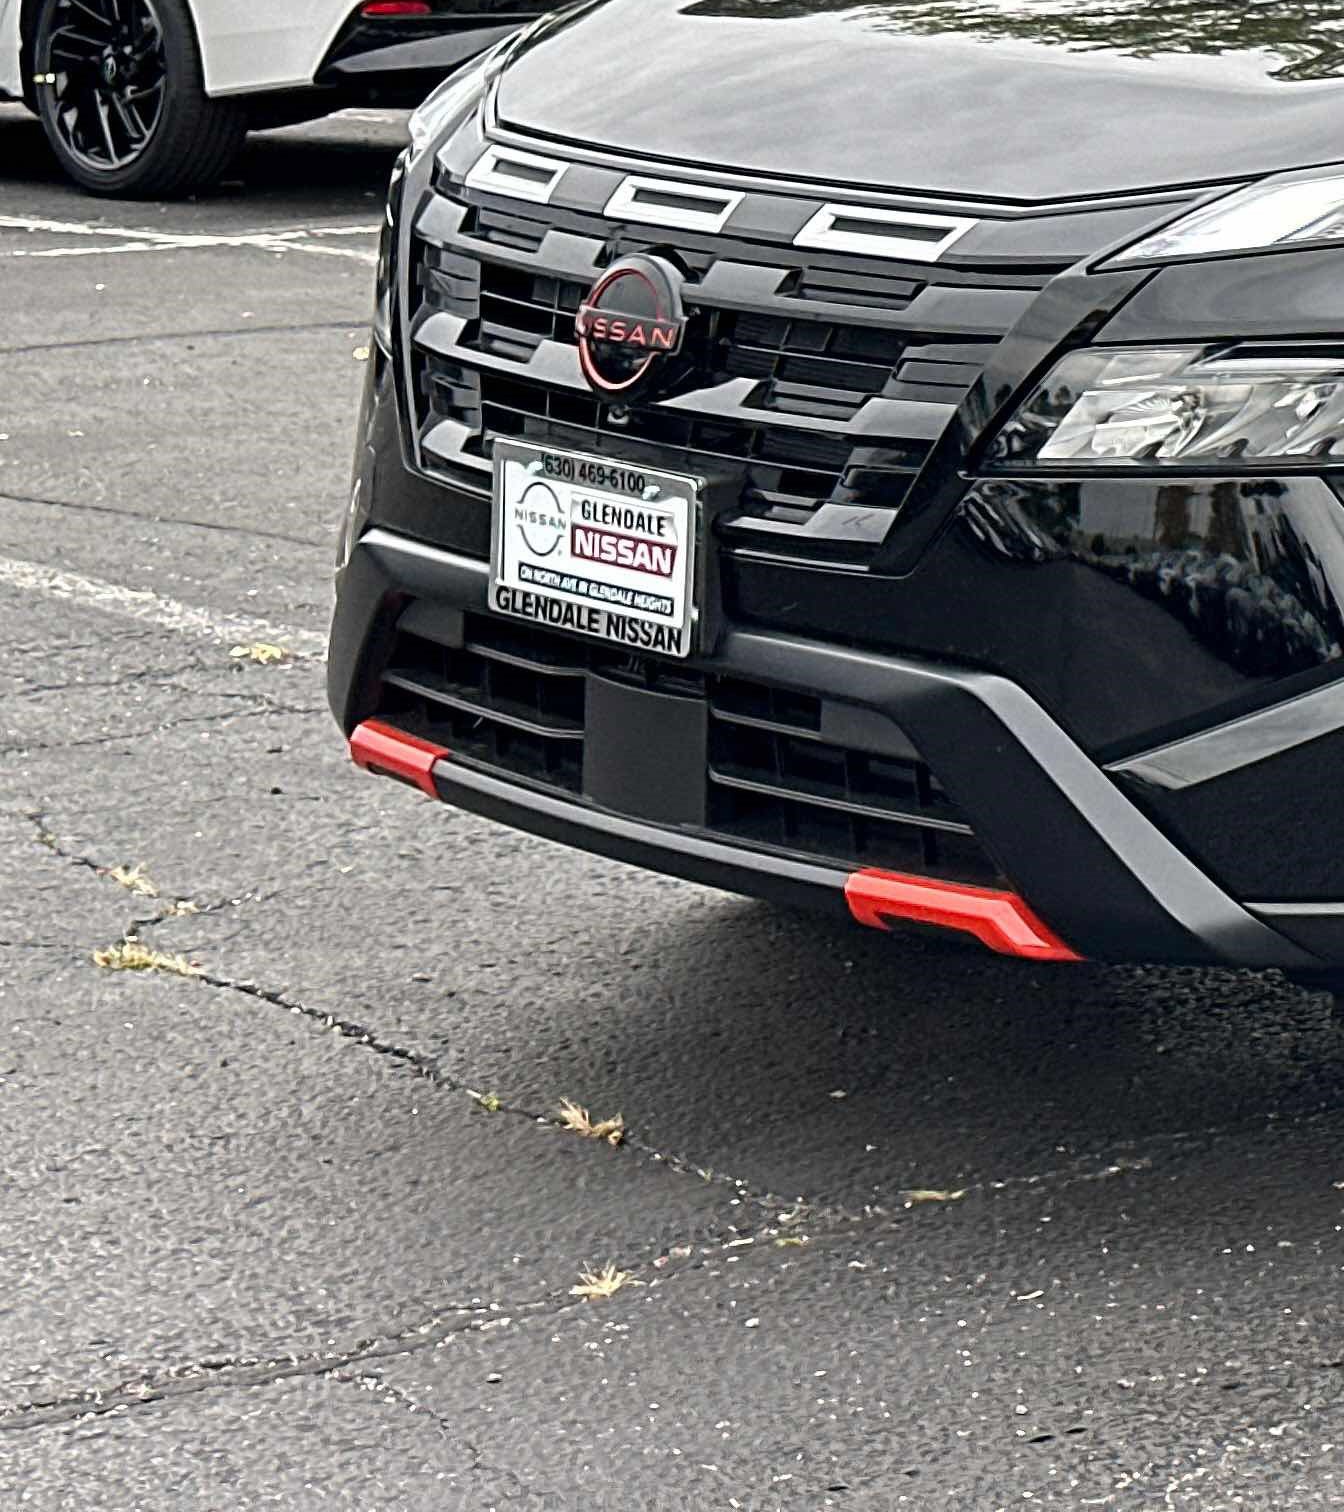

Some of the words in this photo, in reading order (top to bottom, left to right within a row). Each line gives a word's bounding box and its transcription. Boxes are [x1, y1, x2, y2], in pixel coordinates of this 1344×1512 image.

[578, 312, 674, 349] SSAN
[578, 462, 646, 494] 469-6100
[514, 508, 566, 530] NISSAN
[581, 499, 666, 537] GLENDALE
[575, 528, 673, 575] NISSAN
[495, 585, 600, 633] GLENDALE
[606, 614, 682, 655] NISSAN
